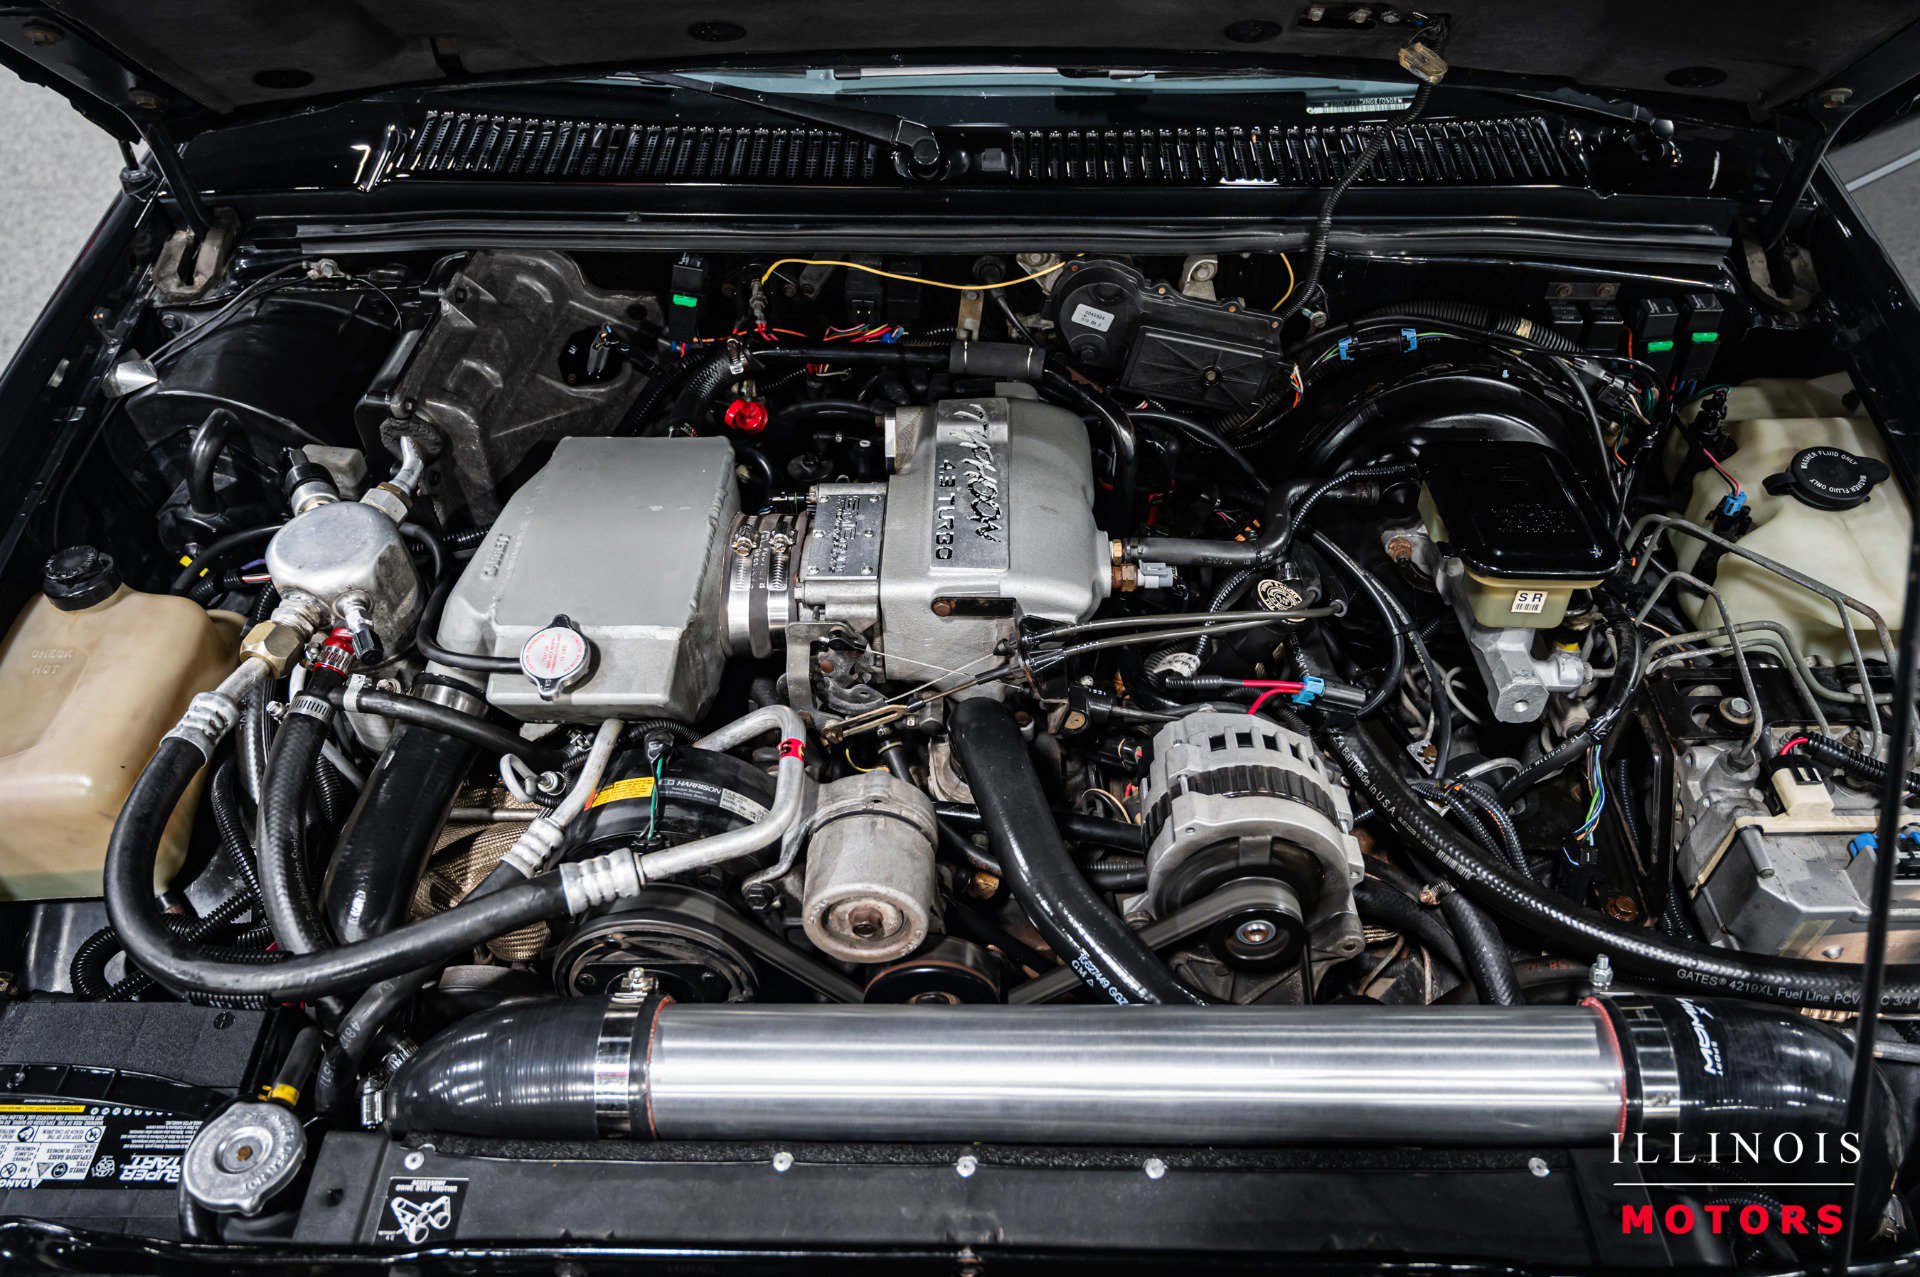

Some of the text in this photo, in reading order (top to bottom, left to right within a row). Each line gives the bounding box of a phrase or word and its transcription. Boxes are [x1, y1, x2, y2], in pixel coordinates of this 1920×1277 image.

[1801, 452, 1818, 469] WASHER
[1841, 454, 1858, 465] ONLY
[950, 403, 1002, 543] TYPHOON
[1809, 479, 1827, 490] ONLY
[1829, 486, 1850, 494] FLUID
[934, 492, 955, 559] TURBO
[32, 664, 60, 674] HOT
[676, 780, 722, 795] HARRISON
[1354, 762, 1370, 787] Made
[1368, 783, 1377, 795] in
[1375, 791, 1396, 817] U.S.A.
[1071, 960, 1087, 978] GM
[1729, 981, 1773, 996] 4219XL
[1778, 987, 1802, 999] Fuel
[1806, 990, 1830, 1002] Line
[1893, 996, 1917, 1007] 3/4"
[123, 1157, 180, 1169] TART
[120, 1170, 180, 1182] SUPER
